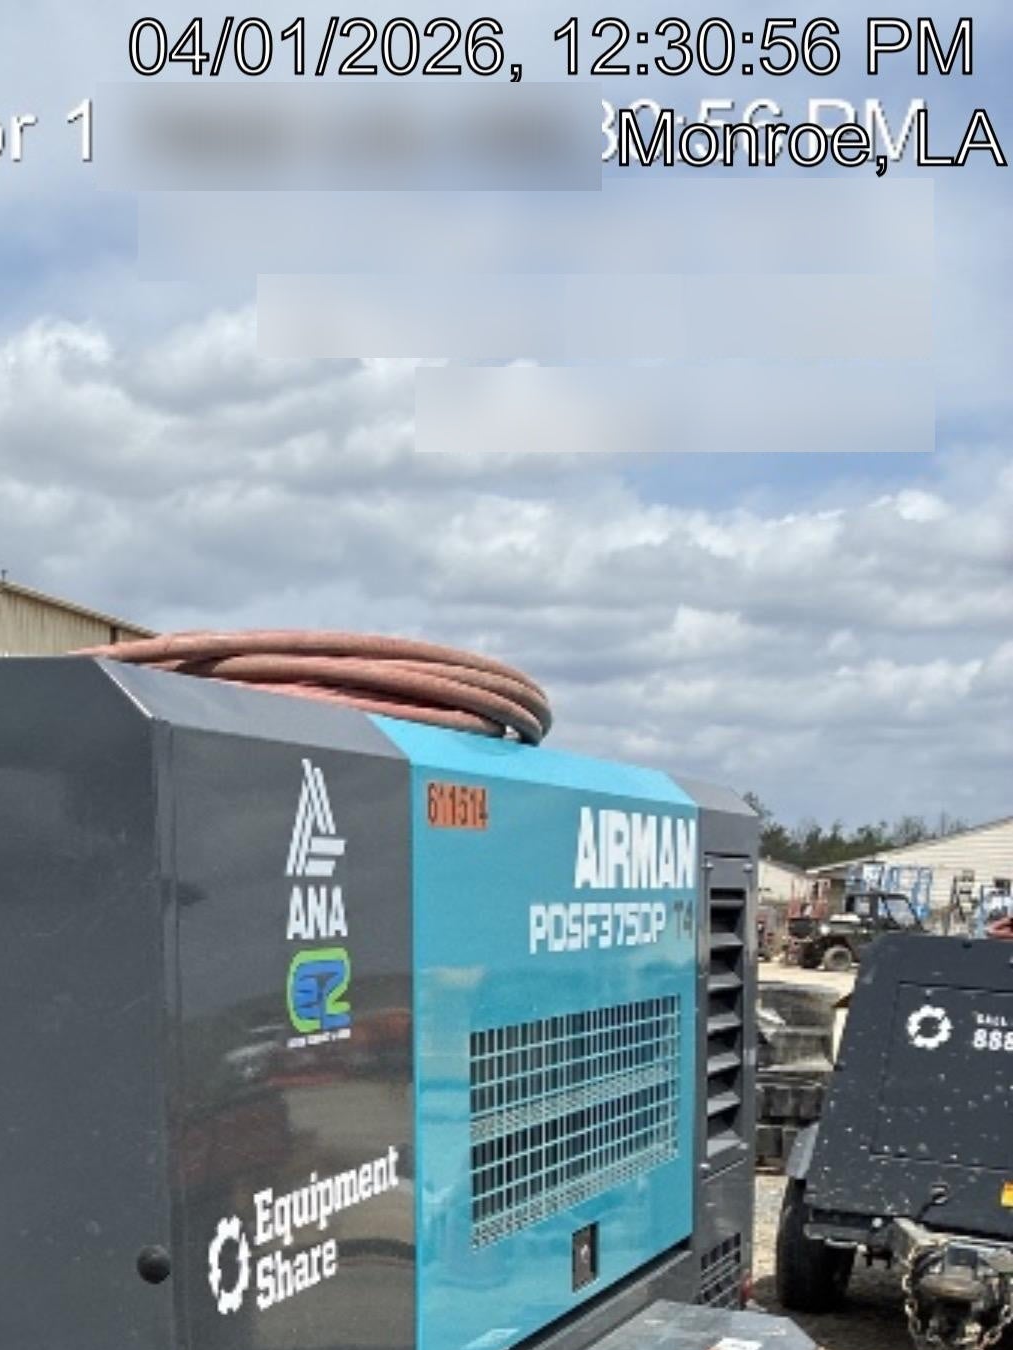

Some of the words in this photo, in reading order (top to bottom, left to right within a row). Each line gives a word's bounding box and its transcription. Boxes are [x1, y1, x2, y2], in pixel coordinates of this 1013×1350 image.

[574, 806, 696, 889] AIRMAN
[287, 885, 348, 939] ANA
[253, 1145, 399, 1246] Equipment
[256, 1238, 338, 1312] Share
